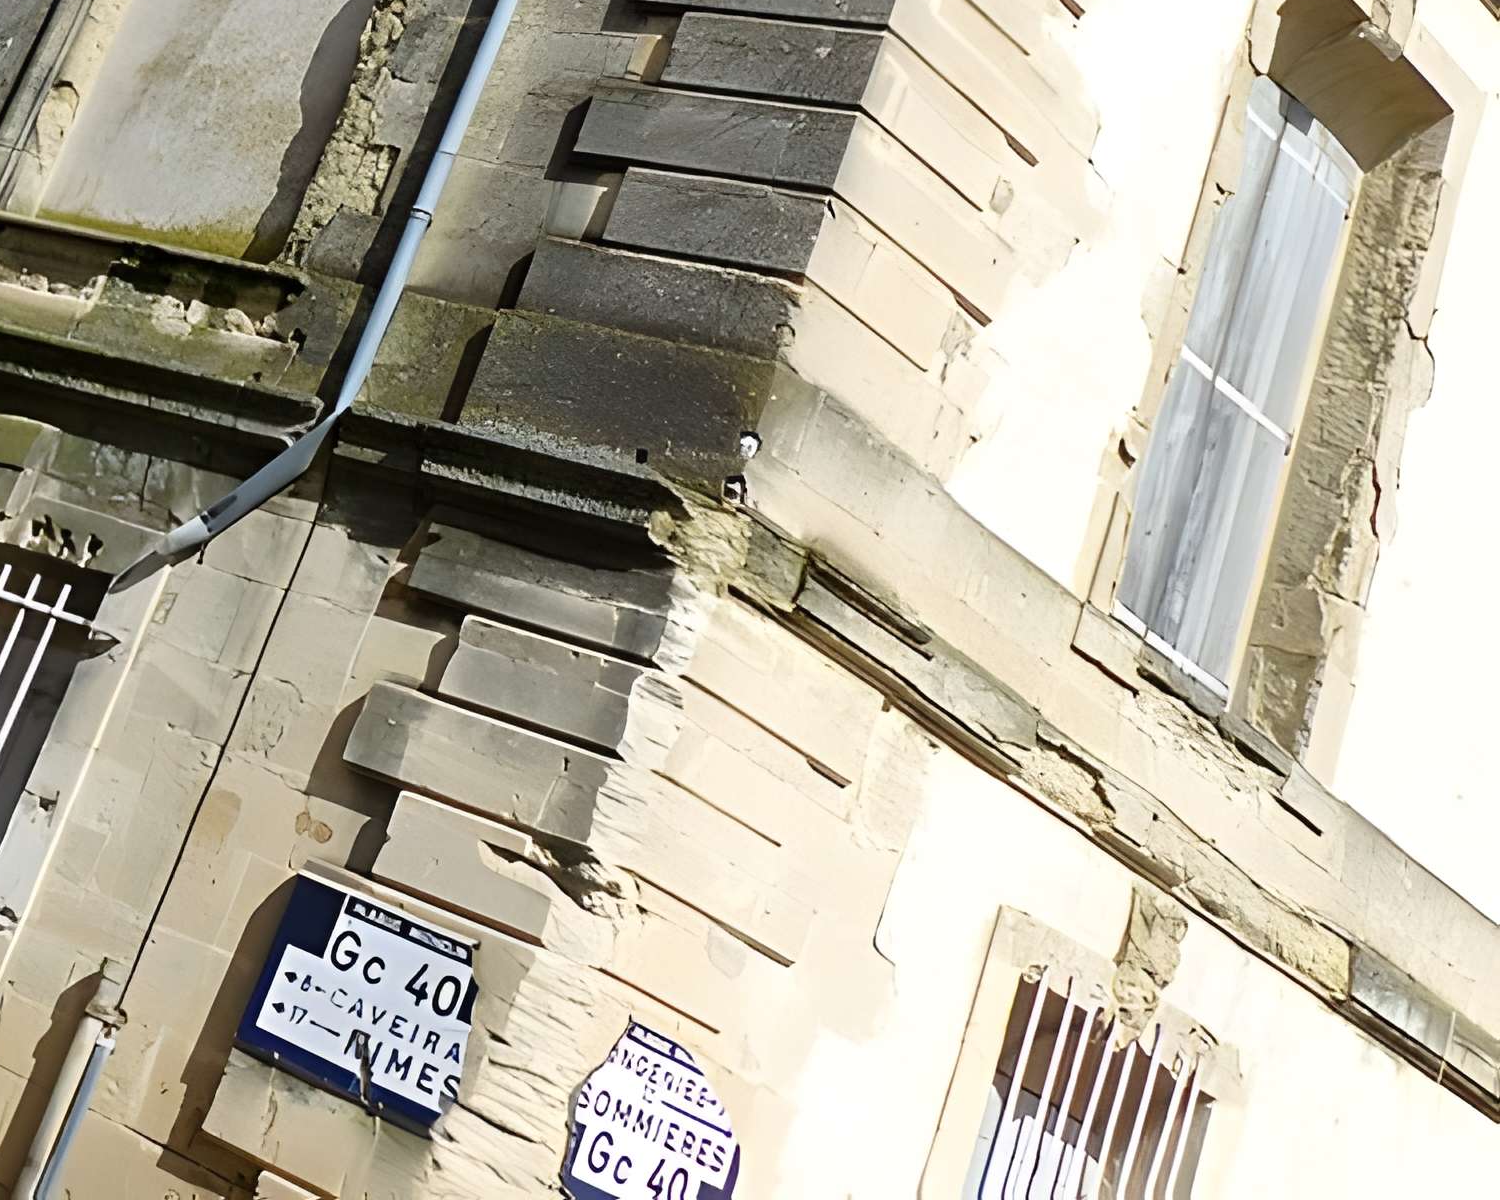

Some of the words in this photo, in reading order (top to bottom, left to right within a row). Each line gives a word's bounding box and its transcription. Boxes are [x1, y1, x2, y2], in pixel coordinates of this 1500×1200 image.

[330, 930, 386, 985] Gc
[404, 963, 462, 1017] 40
[587, 1131, 633, 1185] Gc
[646, 1158, 689, 1200] 40
